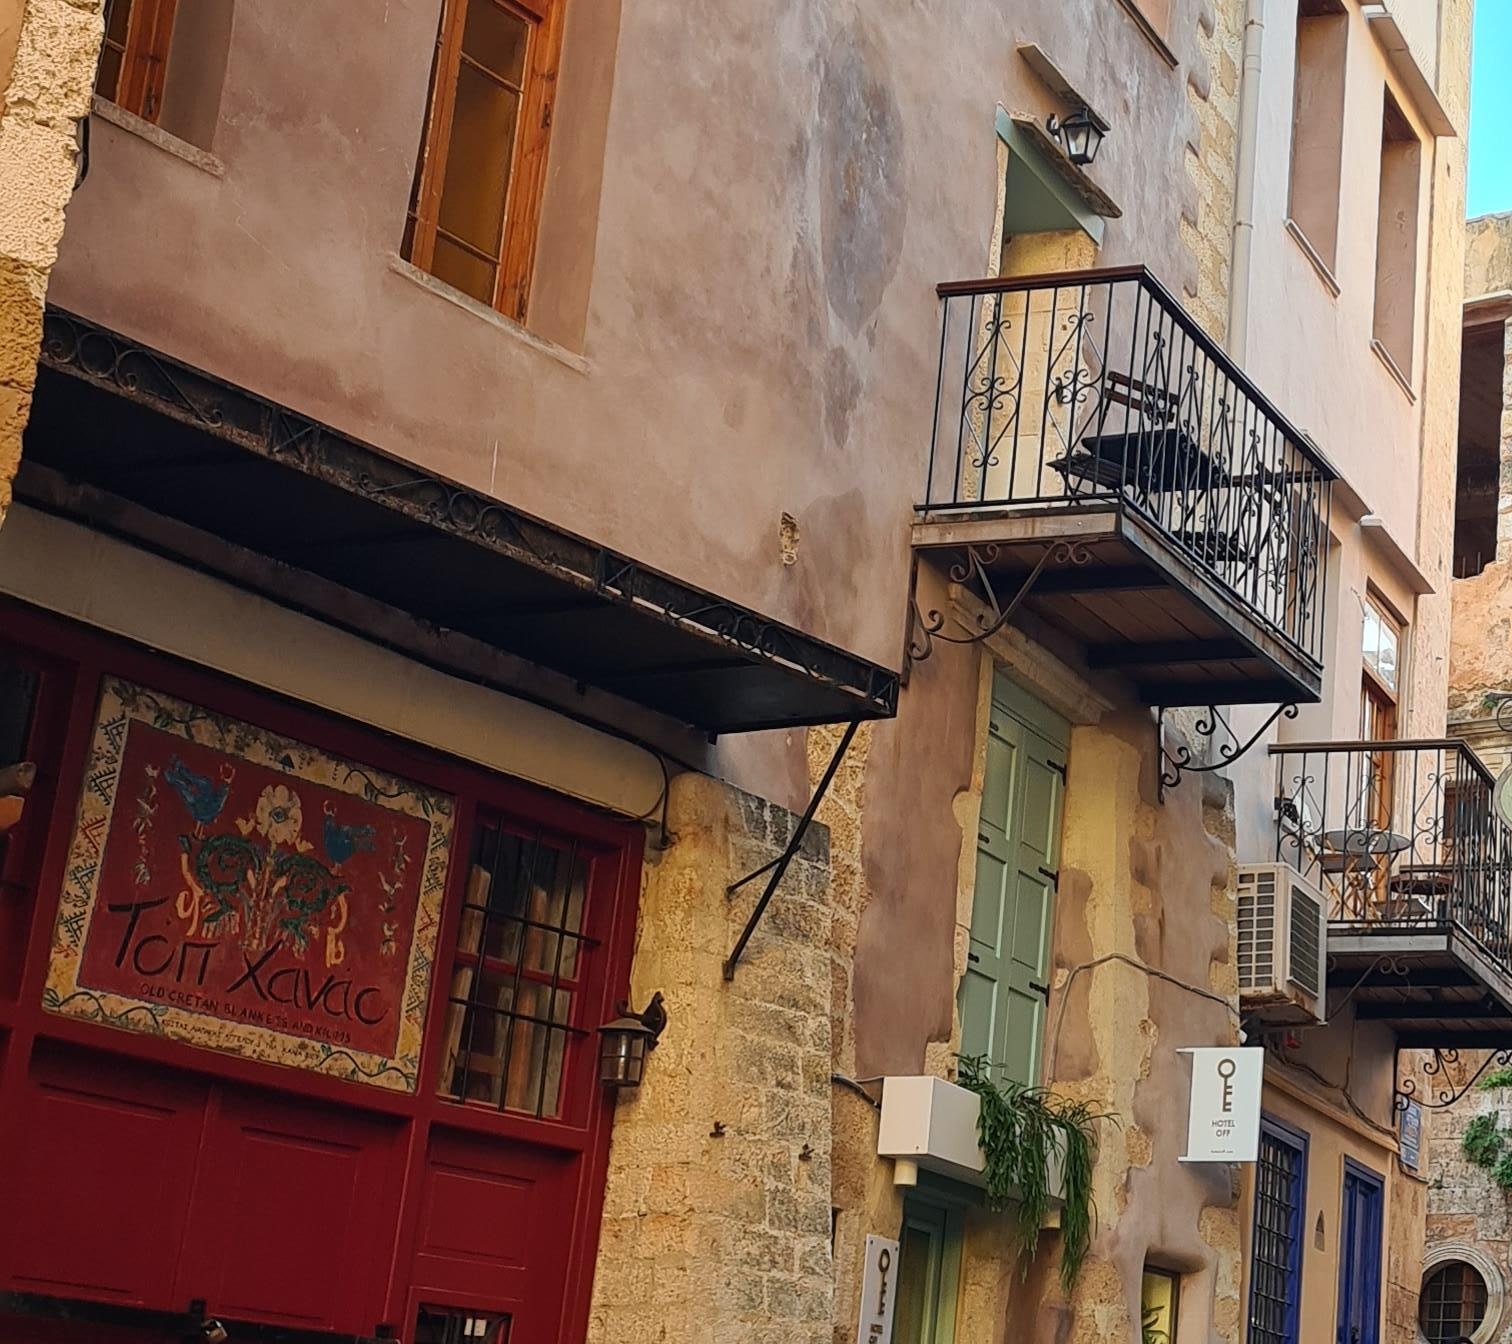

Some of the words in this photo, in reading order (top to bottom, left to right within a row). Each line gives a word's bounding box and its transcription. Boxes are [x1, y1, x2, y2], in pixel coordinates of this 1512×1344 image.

[141, 983, 166, 1000] OLD
[168, 988, 220, 1013] CRETAN
[1211, 1120, 1235, 1128] HOTEL
[1216, 1129, 1231, 1138] OFF
